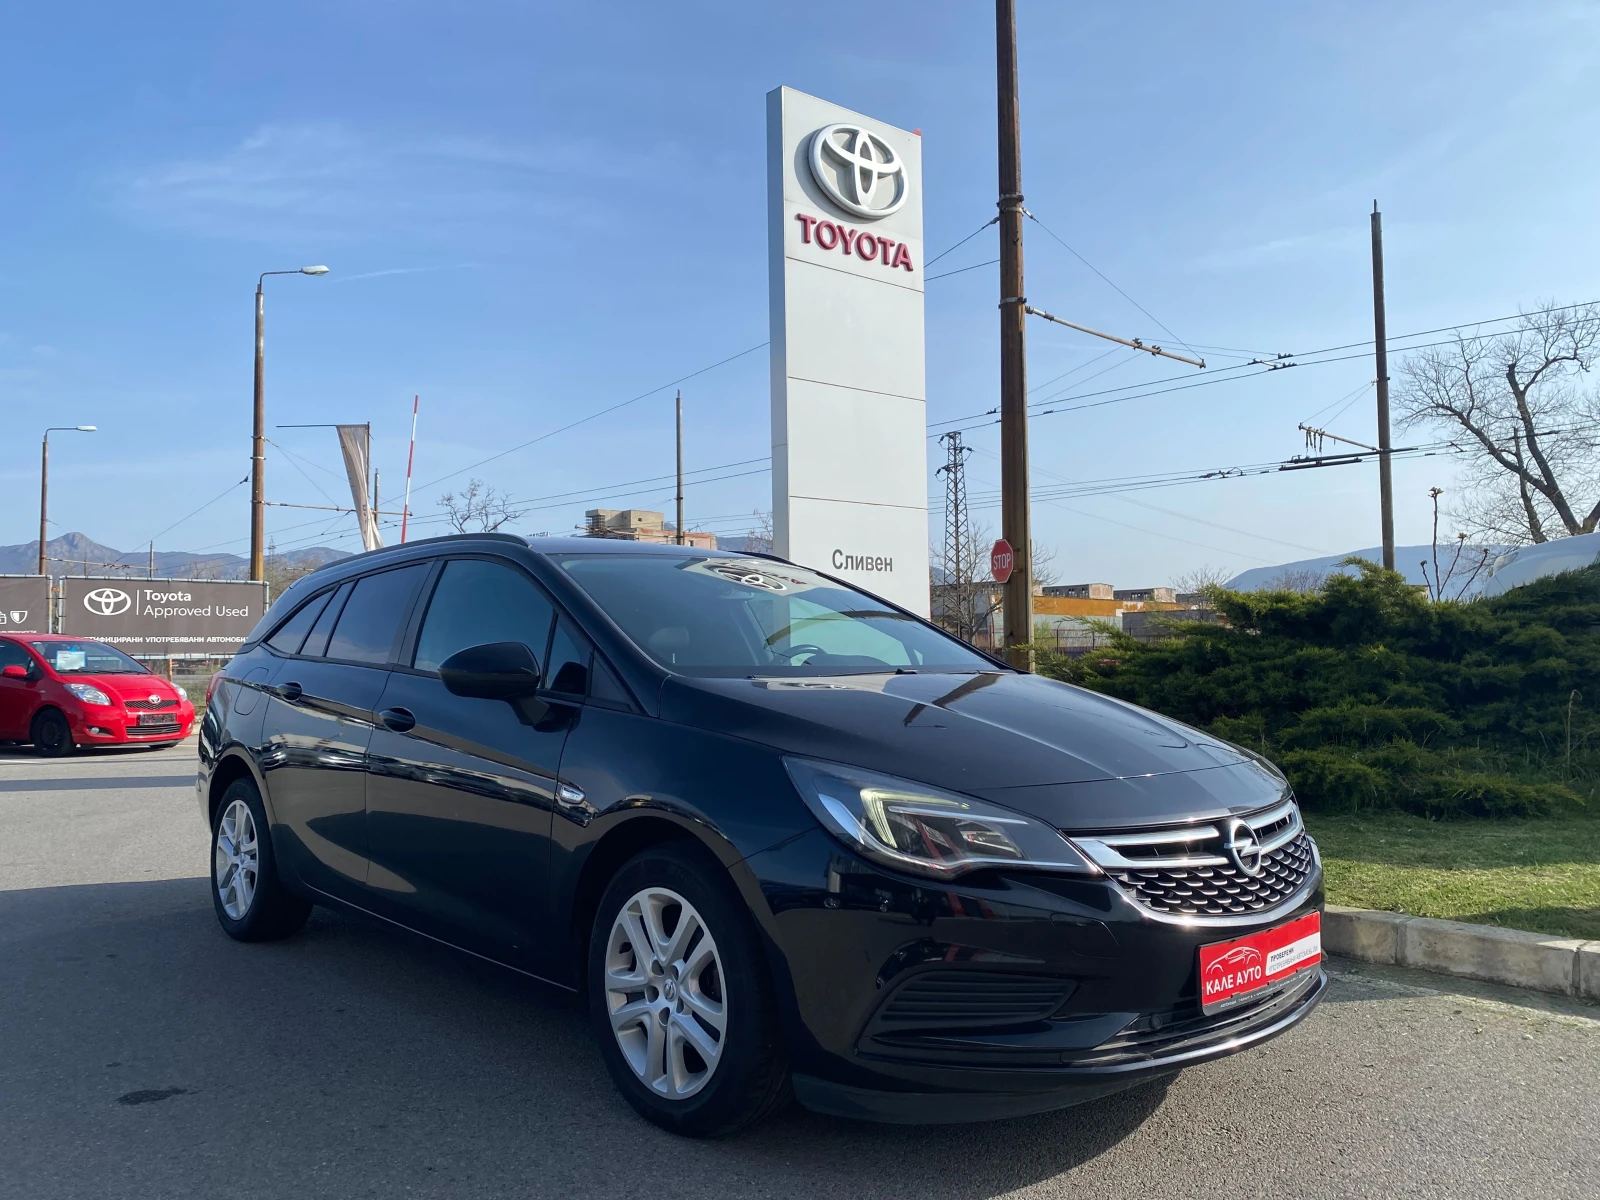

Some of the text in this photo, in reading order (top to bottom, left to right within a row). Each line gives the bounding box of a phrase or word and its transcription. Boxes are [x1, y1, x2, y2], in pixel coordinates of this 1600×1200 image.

[797, 212, 914, 272] TOYOTA
[831, 548, 893, 572] Сливен
[993, 553, 1012, 570] STOP
[143, 589, 192, 604] Toyota
[143, 604, 249, 619] Approved Used
[1206, 973, 1234, 995] КАЛЕ
[1236, 965, 1262, 986] АУТО
